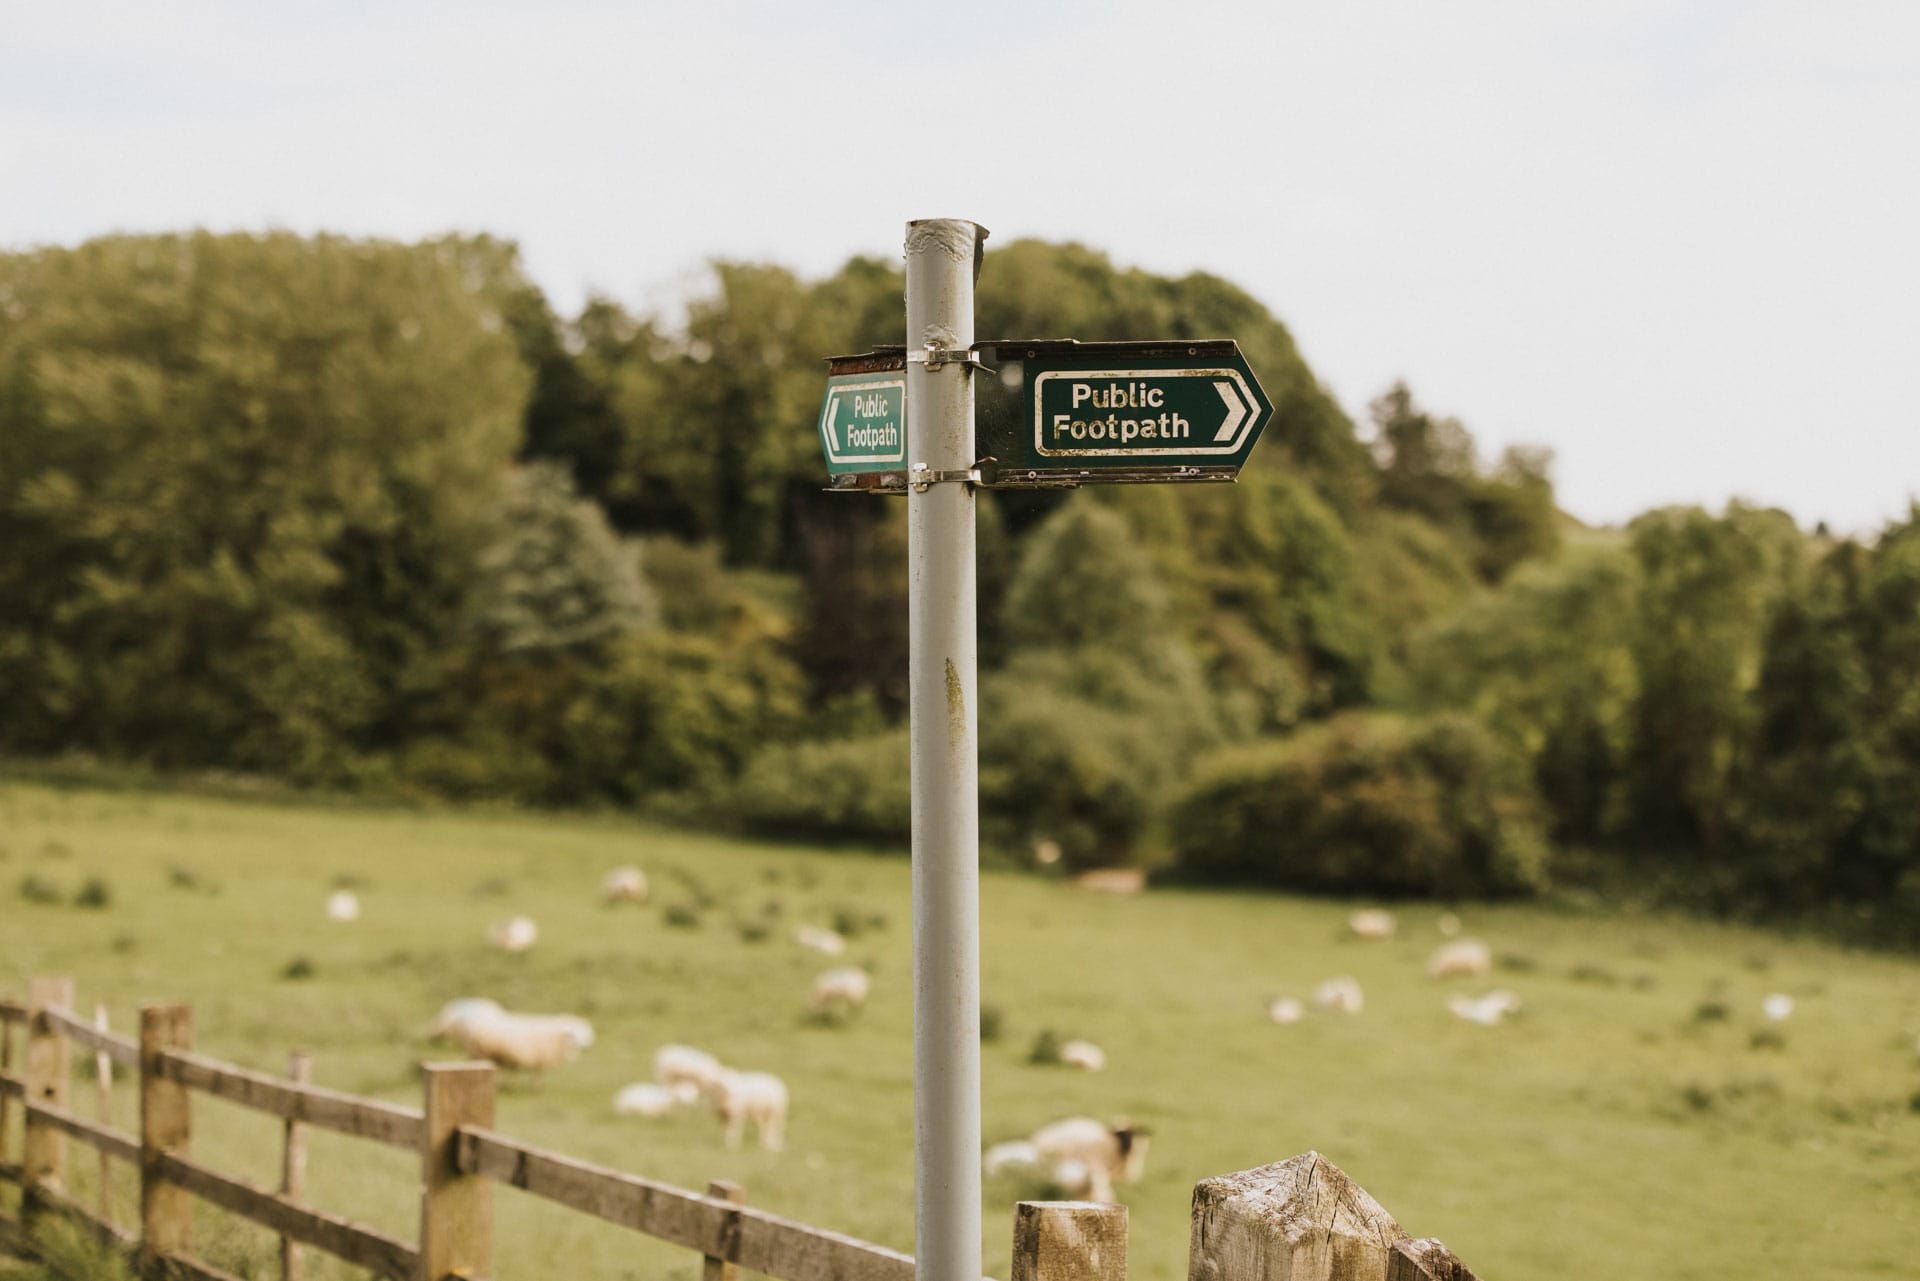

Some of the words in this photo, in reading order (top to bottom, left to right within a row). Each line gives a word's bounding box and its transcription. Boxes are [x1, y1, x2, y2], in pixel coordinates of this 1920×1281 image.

[854, 393, 888, 418] Public
[1072, 382, 1164, 409] Public
[847, 422, 897, 450] Footpath
[1053, 412, 1190, 443] Footpath
